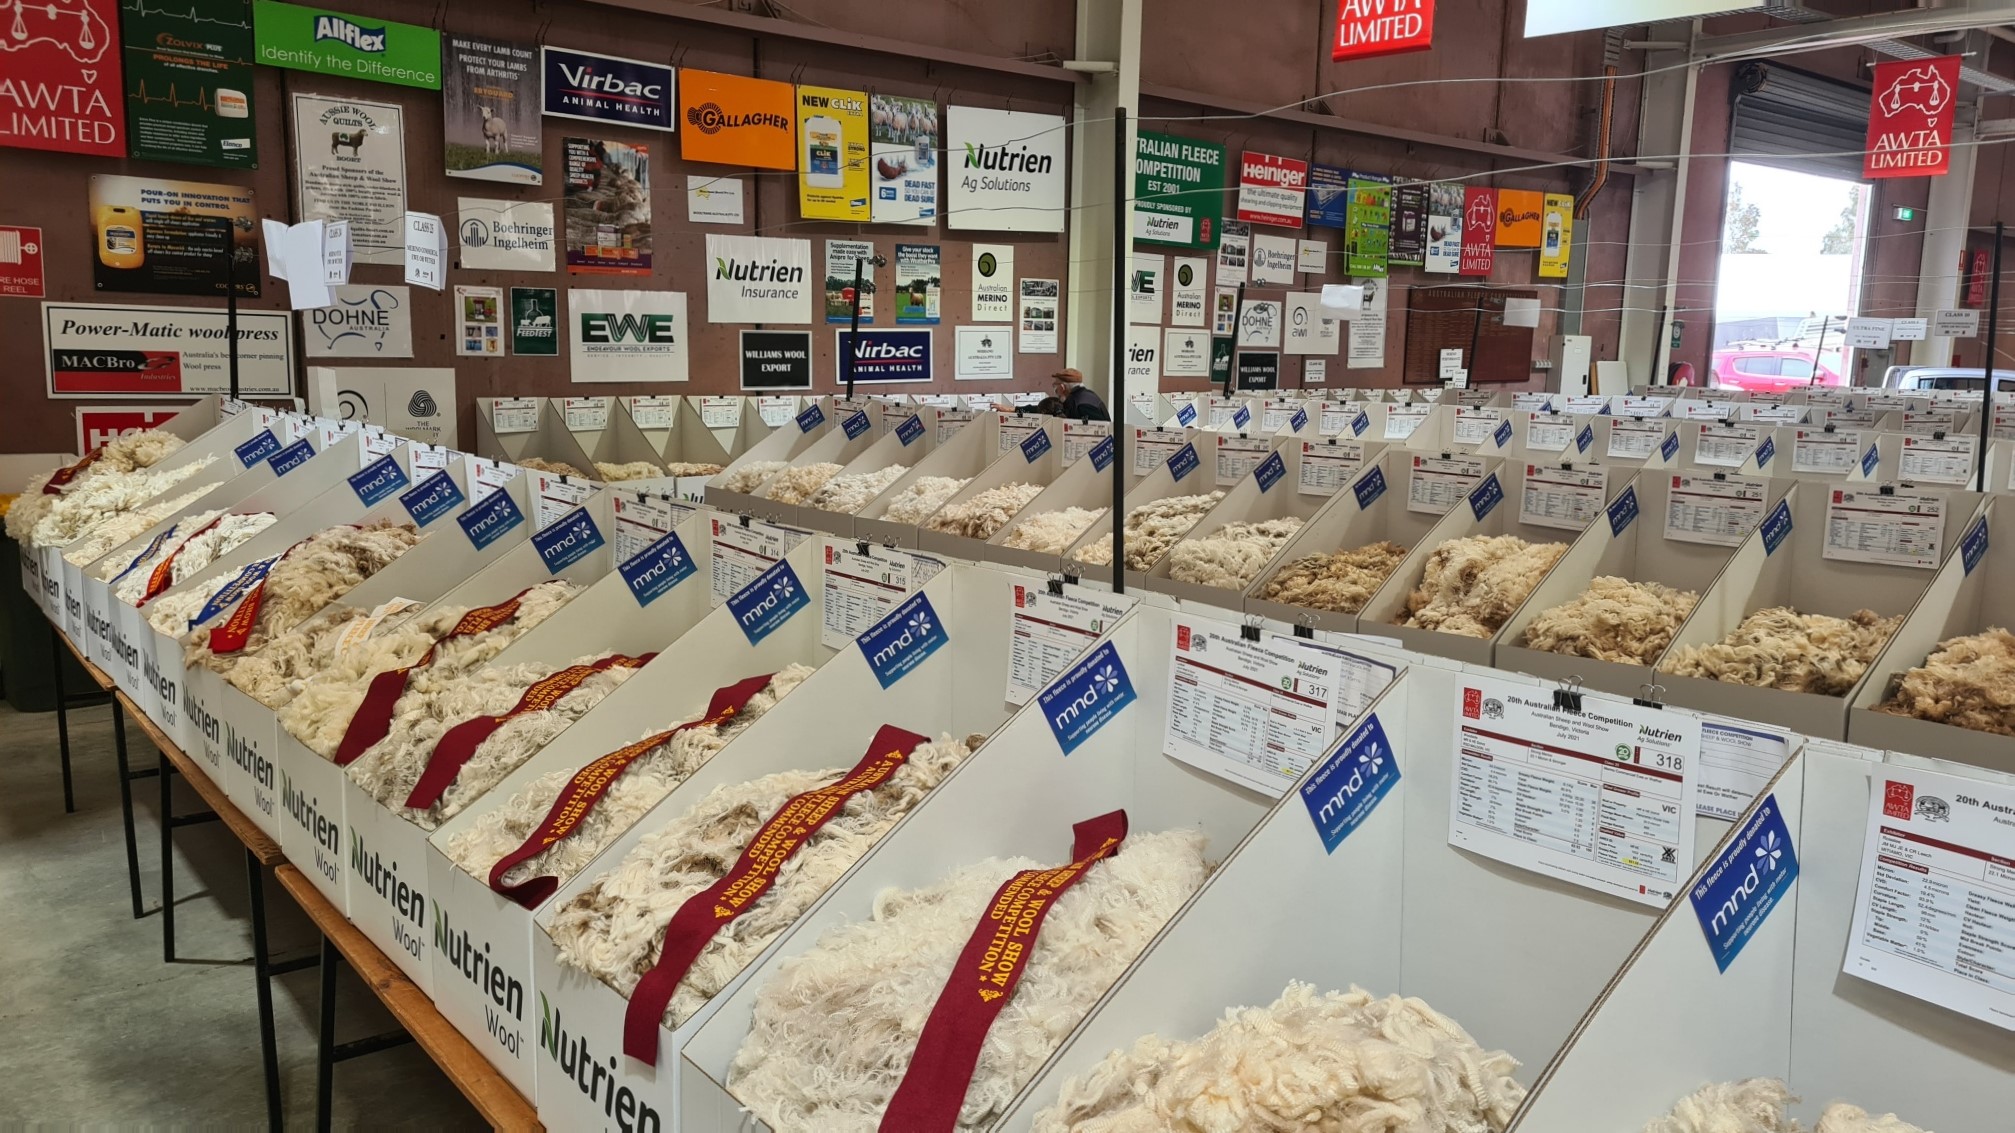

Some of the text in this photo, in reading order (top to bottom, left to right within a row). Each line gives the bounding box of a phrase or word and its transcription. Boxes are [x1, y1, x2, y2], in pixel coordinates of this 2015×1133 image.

[315, 16, 385, 51] Allflex
[1340, 13, 1422, 46] LIMITED
[452, 39, 533, 59] MAKE EVERY LAMB COUNT
[153, 54, 194, 65] PROLONGS
[196, 59, 210, 67] THE
[261, 45, 435, 83] Identify the Difference
[459, 54, 527, 72] PROTECT YOUR LAMBS
[466, 64, 486, 75] FROM
[557, 63, 661, 99] Virbac
[0, 78, 112, 117] AWTA
[563, 96, 660, 117] ANIMAL HEALTH
[802, 95, 829, 108] NEW
[319, 106, 377, 131] AUSSIE WOOL
[333, 117, 363, 127] QUILTS
[703, 111, 788, 131] GALLAGHER
[1873, 130, 1941, 151] AWTA
[965, 142, 1052, 174] Nutrien
[1182, 145, 1219, 165] FLEECE
[1870, 149, 1942, 169] LIMITED
[904, 180, 935, 189] DEAD FAST
[961, 176, 1031, 193] Ag Solutions
[1243, 163, 1305, 187] Heiniger
[141, 189, 178, 198] POUR-ON
[181, 192, 230, 203] INNOVATION
[1148, 180, 1180, 194] EST 2001
[195, 201, 230, 210] CONTROL
[904, 194, 935, 203] DEAD SURE
[493, 221, 553, 236] Boehringer
[1147, 216, 1179, 230] Nutrien
[493, 237, 549, 250] Ingelheim
[830, 242, 868, 250] Supplementation
[1464, 242, 1491, 257] AWTA
[1267, 250, 1295, 261] Boehringer
[1463, 258, 1490, 270] LIMITED
[716, 257, 804, 283] Nutrien
[13, 277, 39, 285] HOSE
[978, 283, 1008, 292] Australian
[741, 285, 799, 300] Insurance
[977, 295, 1008, 303] MERINO
[977, 304, 1008, 312] Direct
[1177, 301, 1200, 309] MERINO
[313, 309, 389, 326] DOHNE
[1242, 316, 1273, 327] DOHNE
[61, 319, 279, 341] Power-Matic wool press
[581, 313, 675, 343] EWE
[61, 355, 135, 369] MACBro
[182, 351, 219, 359] Australia's
[745, 350, 806, 359] WILLIAMS WOOL
[183, 362, 202, 370] Wool
[761, 364, 791, 373] EXPORT
[889, 364, 923, 372] HEALTH
[244, 445, 264, 463] mnd
[277, 456, 300, 474] mnd
[359, 474, 383, 496] mnd
[411, 493, 438, 515] mnd
[469, 511, 497, 533] mnd
[544, 536, 576, 558] mnd
[633, 564, 666, 590] mnd
[896, 576, 906, 586] 315
[741, 596, 779, 626] mnd
[873, 629, 912, 666] mnd
[143, 647, 176, 705] Nutrien
[1043, 647, 1109, 704] This fleece is proudly donated to
[1298, 661, 1328, 676] Nutrien
[126, 669, 138, 690] Wool
[1309, 685, 1327, 698] 317
[161, 704, 176, 727] Wool
[182, 680, 220, 744] Nutrien
[1056, 684, 1098, 729] mnd
[1507, 695, 1633, 729] 20th Australian Fleece Competition
[1311, 725, 1322, 734] VIC
[1531, 711, 1554, 721] Australian
[1555, 715, 1569, 725] Sheep
[1582, 721, 1595, 730] Wool
[1595, 724, 1609, 732] Show
[1549, 722, 1589, 736] Bendigo, Victoria
[1556, 732, 1568, 740] July
[1637, 736, 1670, 747] Ag Solutions
[1639, 724, 1682, 743] Nutrien
[1720, 730, 1753, 741] COMPETITION
[204, 741, 219, 767] Wool
[225, 721, 274, 790] Nutrien
[1305, 723, 1375, 795] This fleece is proudly donated to
[1656, 753, 1682, 770] 318
[254, 786, 273, 816] Wool
[556, 768, 616, 836] WOOL SHOW
[1319, 767, 1364, 824] mnd
[1956, 795, 1979, 807] 20th
[282, 769, 338, 855] Nutrien
[1662, 804, 1677, 814] VIC
[1716, 807, 1736, 816] PLACE
[748, 798, 805, 858] COMMENDED
[793, 827, 806, 835] &
[721, 823, 793, 898] COMPETITION
[762, 839, 797, 876] WOOL
[1695, 807, 1772, 900] This fleece is proudly donated to
[314, 846, 338, 884] Wool
[1909, 864, 1927, 873] Results
[350, 825, 425, 928] Nutrien
[729, 876, 766, 908] SHOW
[1711, 864, 1760, 936] mnd
[392, 916, 422, 961] Wool
[978, 887, 1035, 973] COMPETITION
[991, 888, 1052, 988] & WOOL SHOW
[433, 898, 524, 1021] Nutrien
[485, 1004, 520, 1059] Wool
[540, 990, 661, 1133] Nutrien
